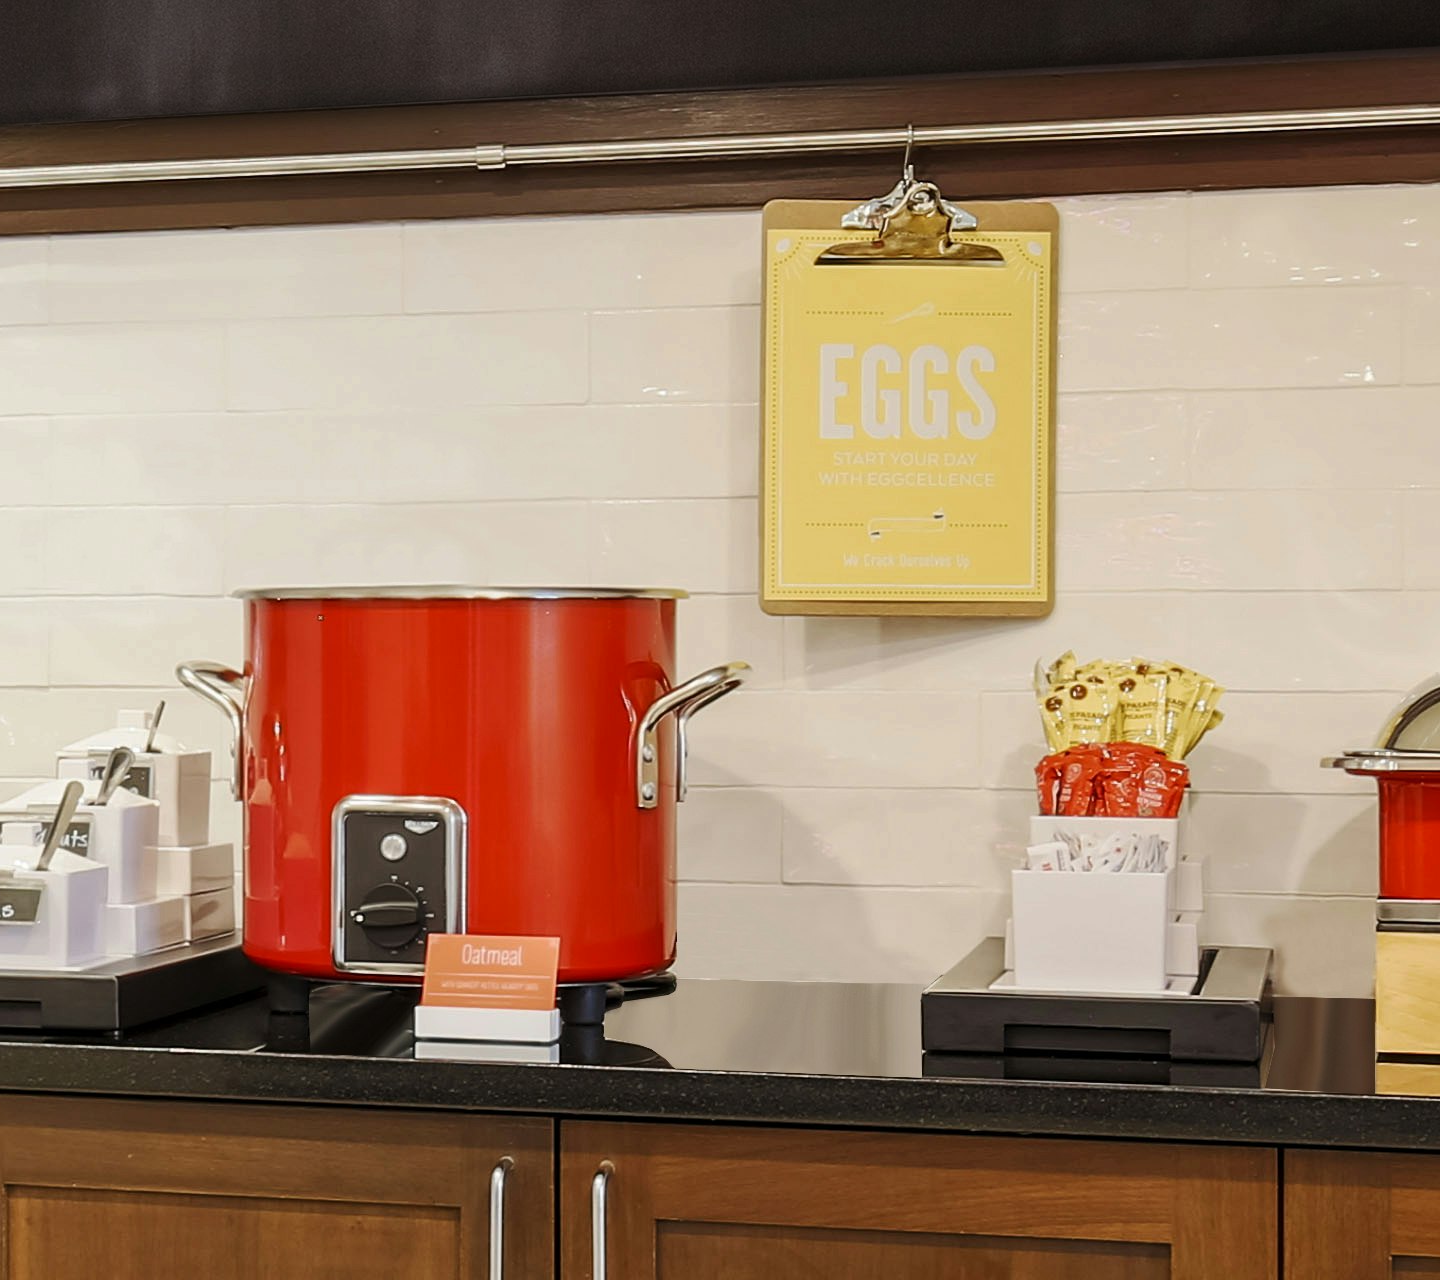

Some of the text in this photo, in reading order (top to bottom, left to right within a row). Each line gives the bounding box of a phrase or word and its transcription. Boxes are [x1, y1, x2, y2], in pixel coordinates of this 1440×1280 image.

[819, 343, 996, 441] EGGS
[833, 451, 977, 466] START YOUR DAY
[819, 472, 995, 487] WITH EGGCELLENCE
[462, 944, 522, 966] Oatmeal
